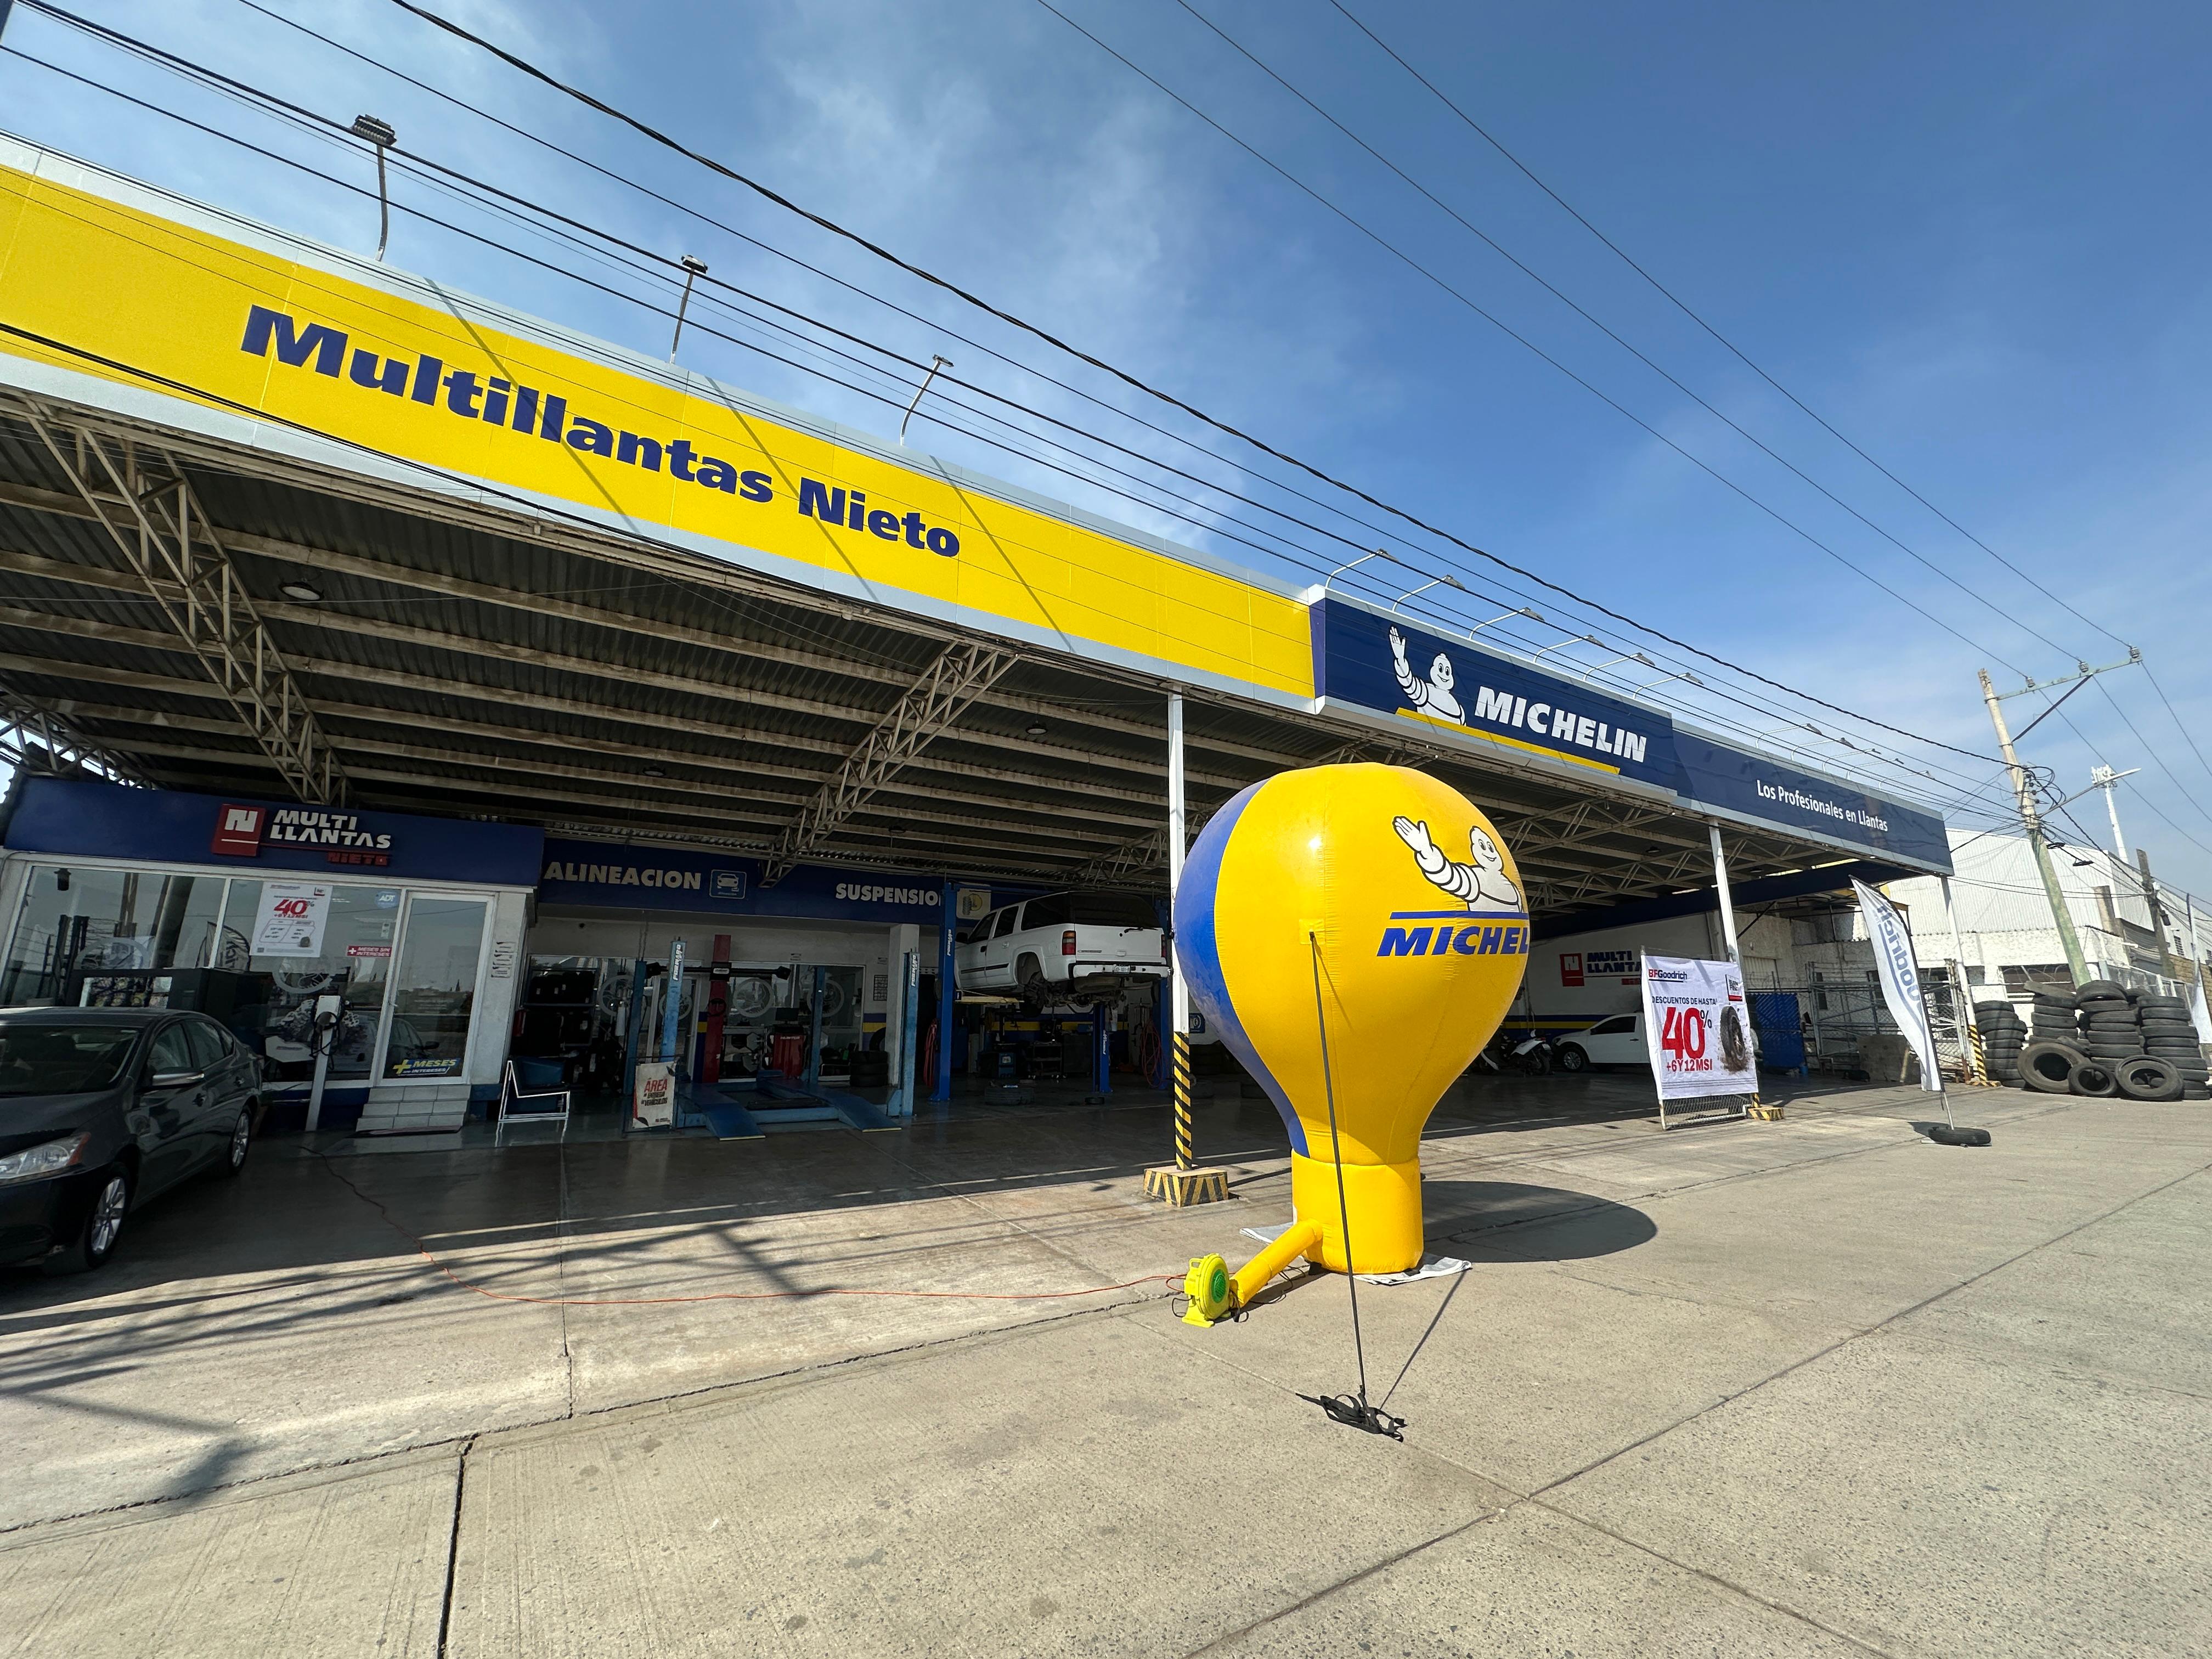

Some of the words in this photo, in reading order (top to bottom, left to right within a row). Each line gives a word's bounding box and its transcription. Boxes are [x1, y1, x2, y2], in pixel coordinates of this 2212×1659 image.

[240, 304, 774, 503] Multillantas
[799, 476, 960, 557] Nieto
[1475, 686, 1647, 763] MICHELIN
[1756, 780, 1776, 800] Los
[1778, 785, 1843, 820] Profesionales
[1846, 809, 1857, 823] en
[1858, 810, 1888, 832] Llantas
[273, 809, 358, 830] MULTI
[269, 825, 391, 849] LLANTAS
[328, 851, 388, 866] NIETO
[544, 861, 702, 890] ALINEACION
[836, 883, 941, 906] SUSPENSIO
[273, 899, 315, 915] 40%
[1376, 926, 1528, 957] MICHEL
[1587, 950, 1633, 962] MULTI
[1587, 962, 1641, 973] LLANTA
[1649, 969, 1687, 980] BFGoodrich
[1652, 996, 1689, 1005] DESCUENTOS
[1662, 1007, 1712, 1060] 40%
[413, 1059, 457, 1068] MESES
[644, 1077, 668, 1092] ÁREA
